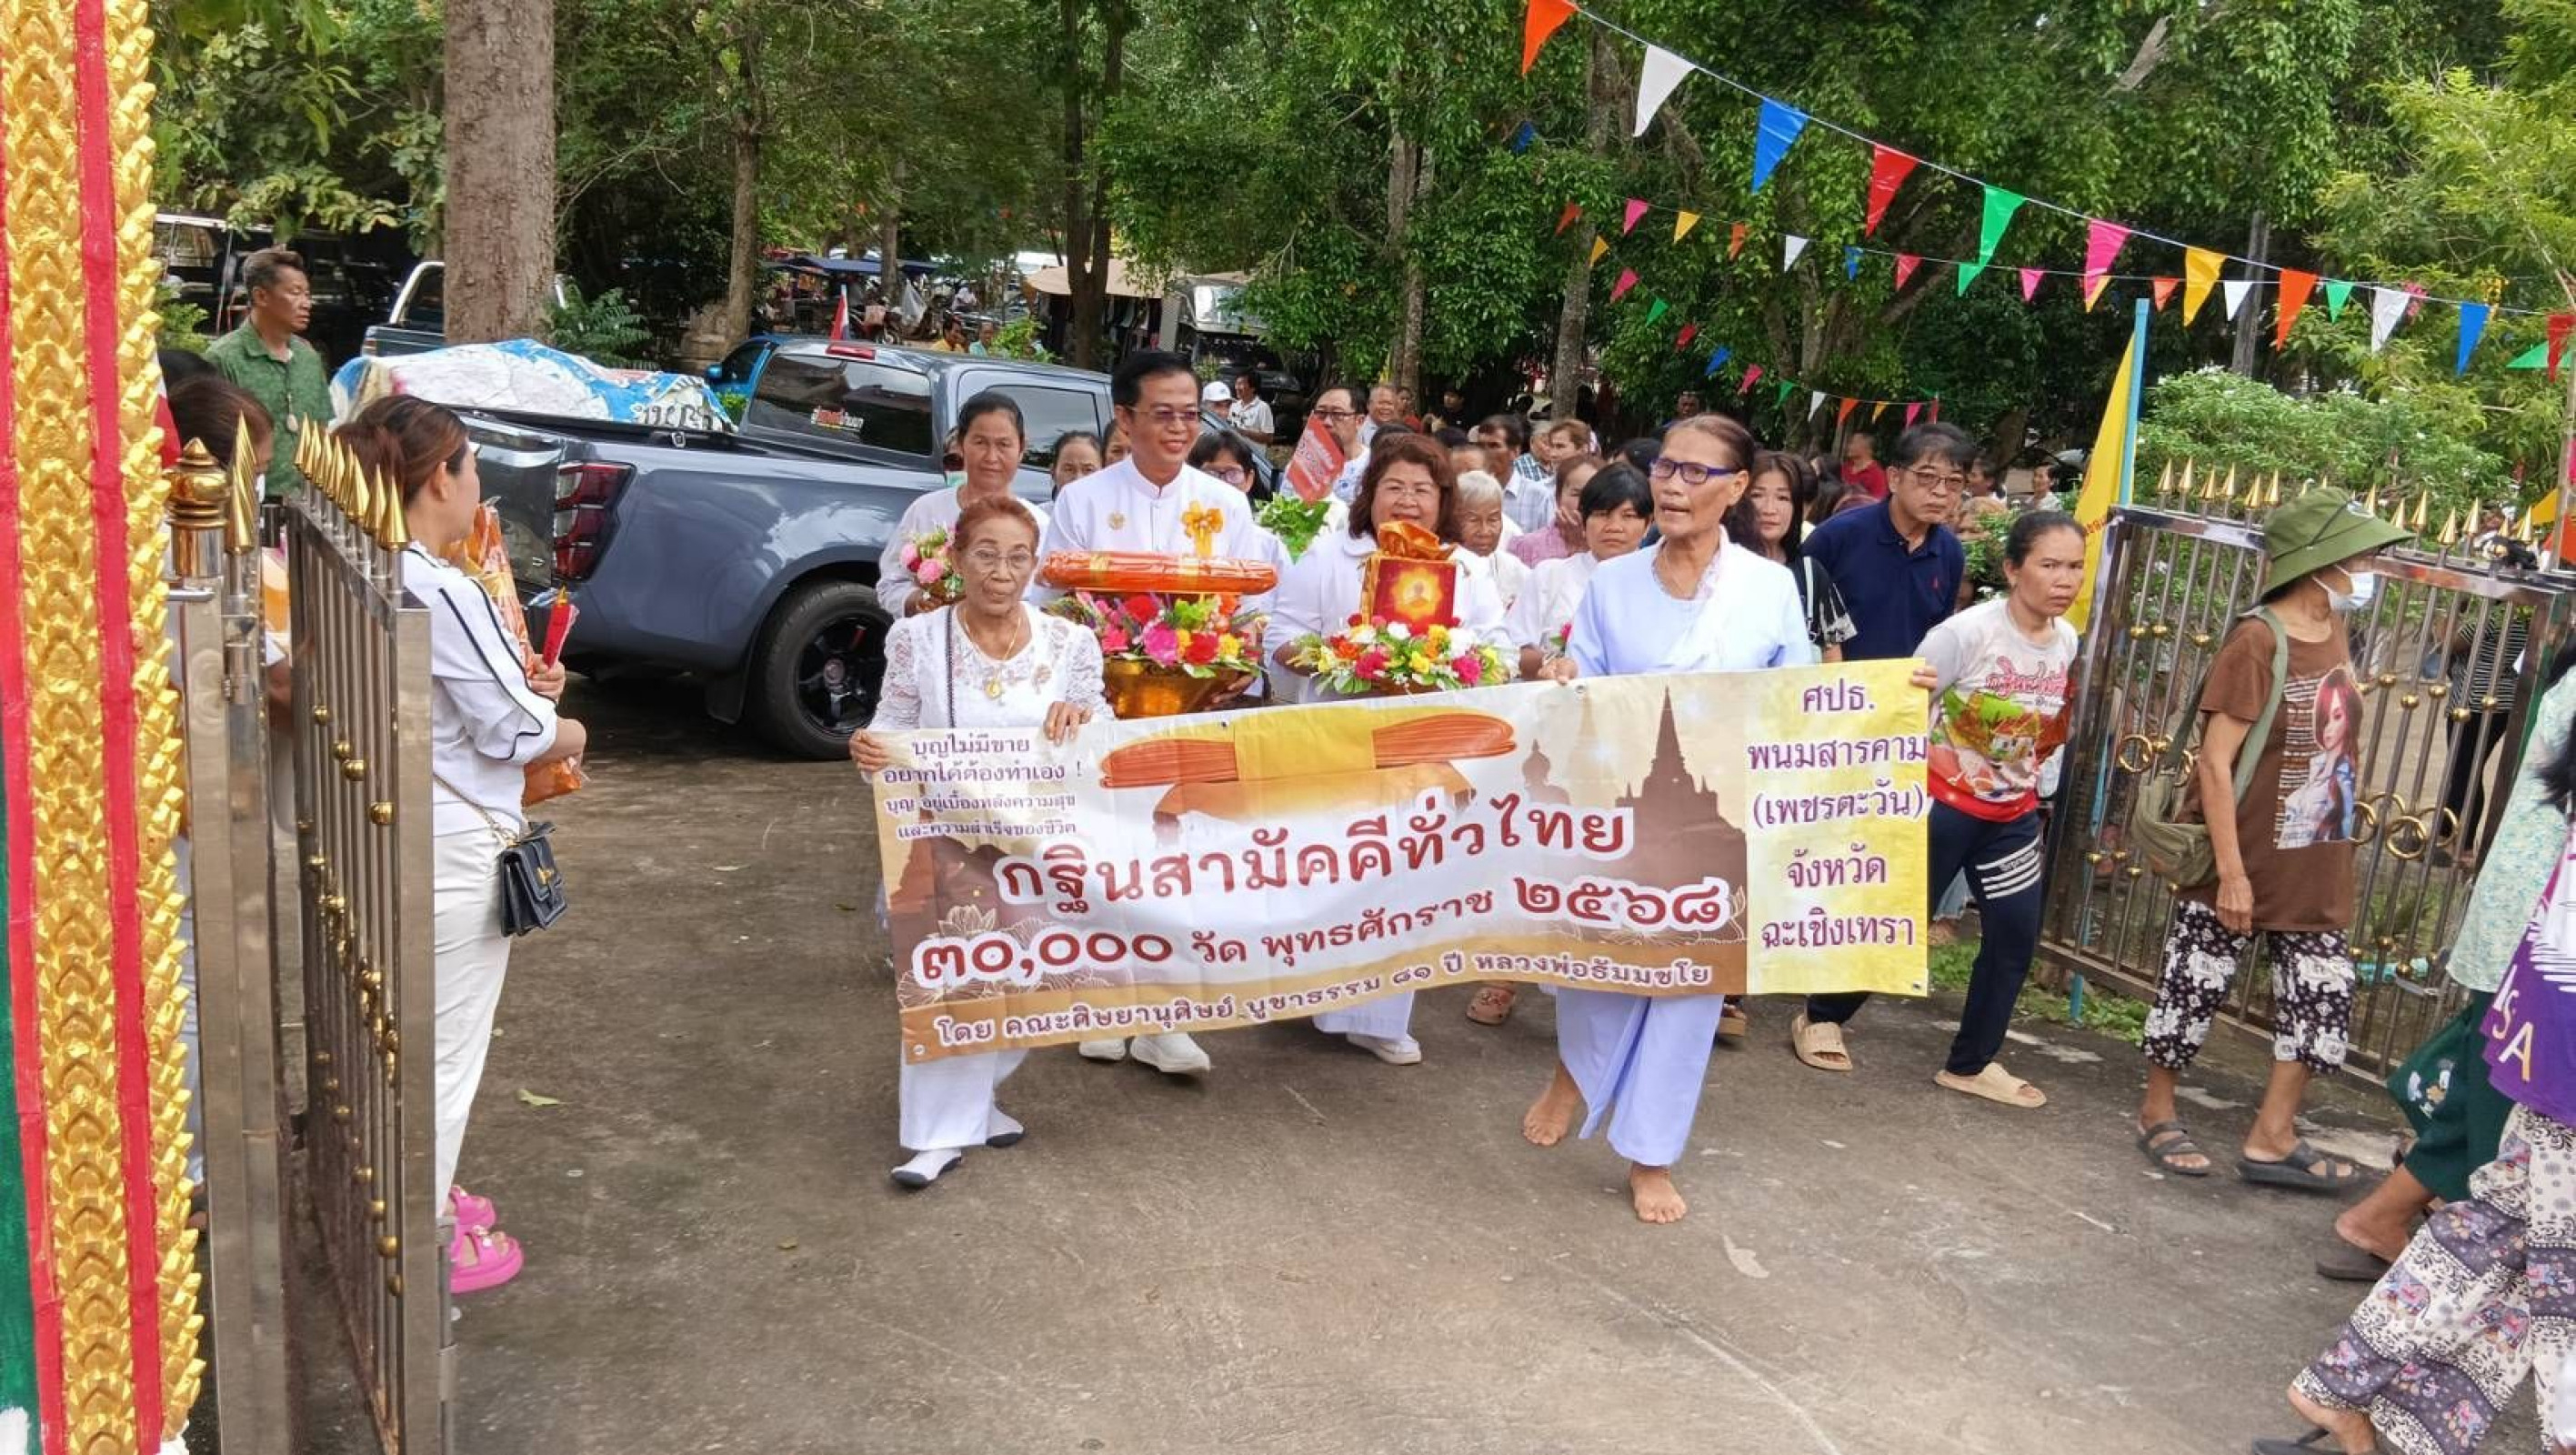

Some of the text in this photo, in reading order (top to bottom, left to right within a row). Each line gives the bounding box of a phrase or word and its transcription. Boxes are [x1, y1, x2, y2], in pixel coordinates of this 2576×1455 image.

[1803, 677, 1875, 712] ศปธ.
[912, 733, 1030, 759] บุญไม่มีขาย
[1747, 736, 1928, 769] พนมสารคาม
[884, 759, 1066, 784] อยากได้ต้องทำเอง
[886, 789, 1077, 815] บุญ อยู่เบื้องหลังความสุข
[1753, 778, 1924, 828] (เพชรตะวัน)
[897, 819, 1077, 838] และความสำเร็จของชีวิต
[1002, 793, 1624, 914] กฐินสามัคคีทั่วไทย
[1788, 842, 1887, 888] จังหวัด
[921, 877, 1721, 980] ๓๐,๐๐๐ วัด พุทธศักราช ๒๕๖๘
[1760, 907, 1914, 948] ฉะเชิงเทรา
[937, 951, 1709, 1043] โดย คณะศิษยานุศิษย์ บูชาธรรม ๘๑ ปี หลวงพ่อธัมมชโย
